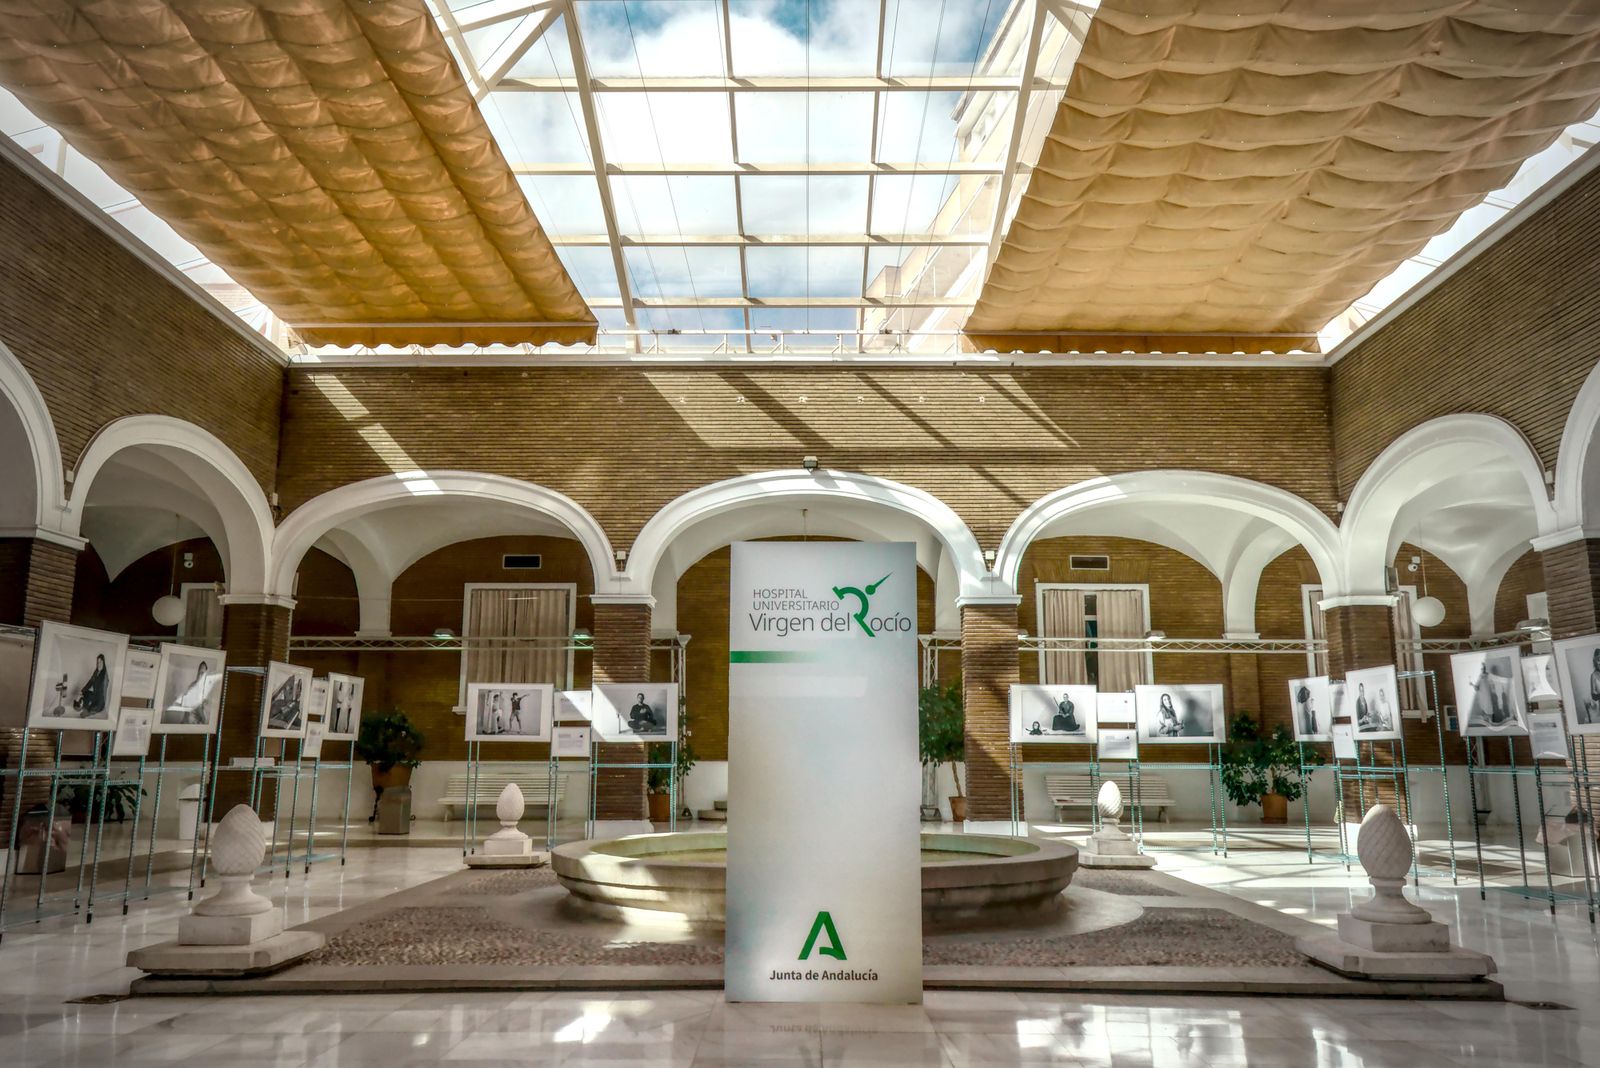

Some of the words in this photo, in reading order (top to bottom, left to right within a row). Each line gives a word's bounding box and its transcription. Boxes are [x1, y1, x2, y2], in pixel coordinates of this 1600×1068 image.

[753, 589, 807, 598] HOSPITAL
[753, 601, 839, 611] UNIVERSITARIO
[749, 613, 814, 637] Virgen
[821, 613, 850, 631] del
[769, 970, 802, 980] Junta
[805, 970, 819, 980] de
[822, 969, 878, 981] Andalucía
